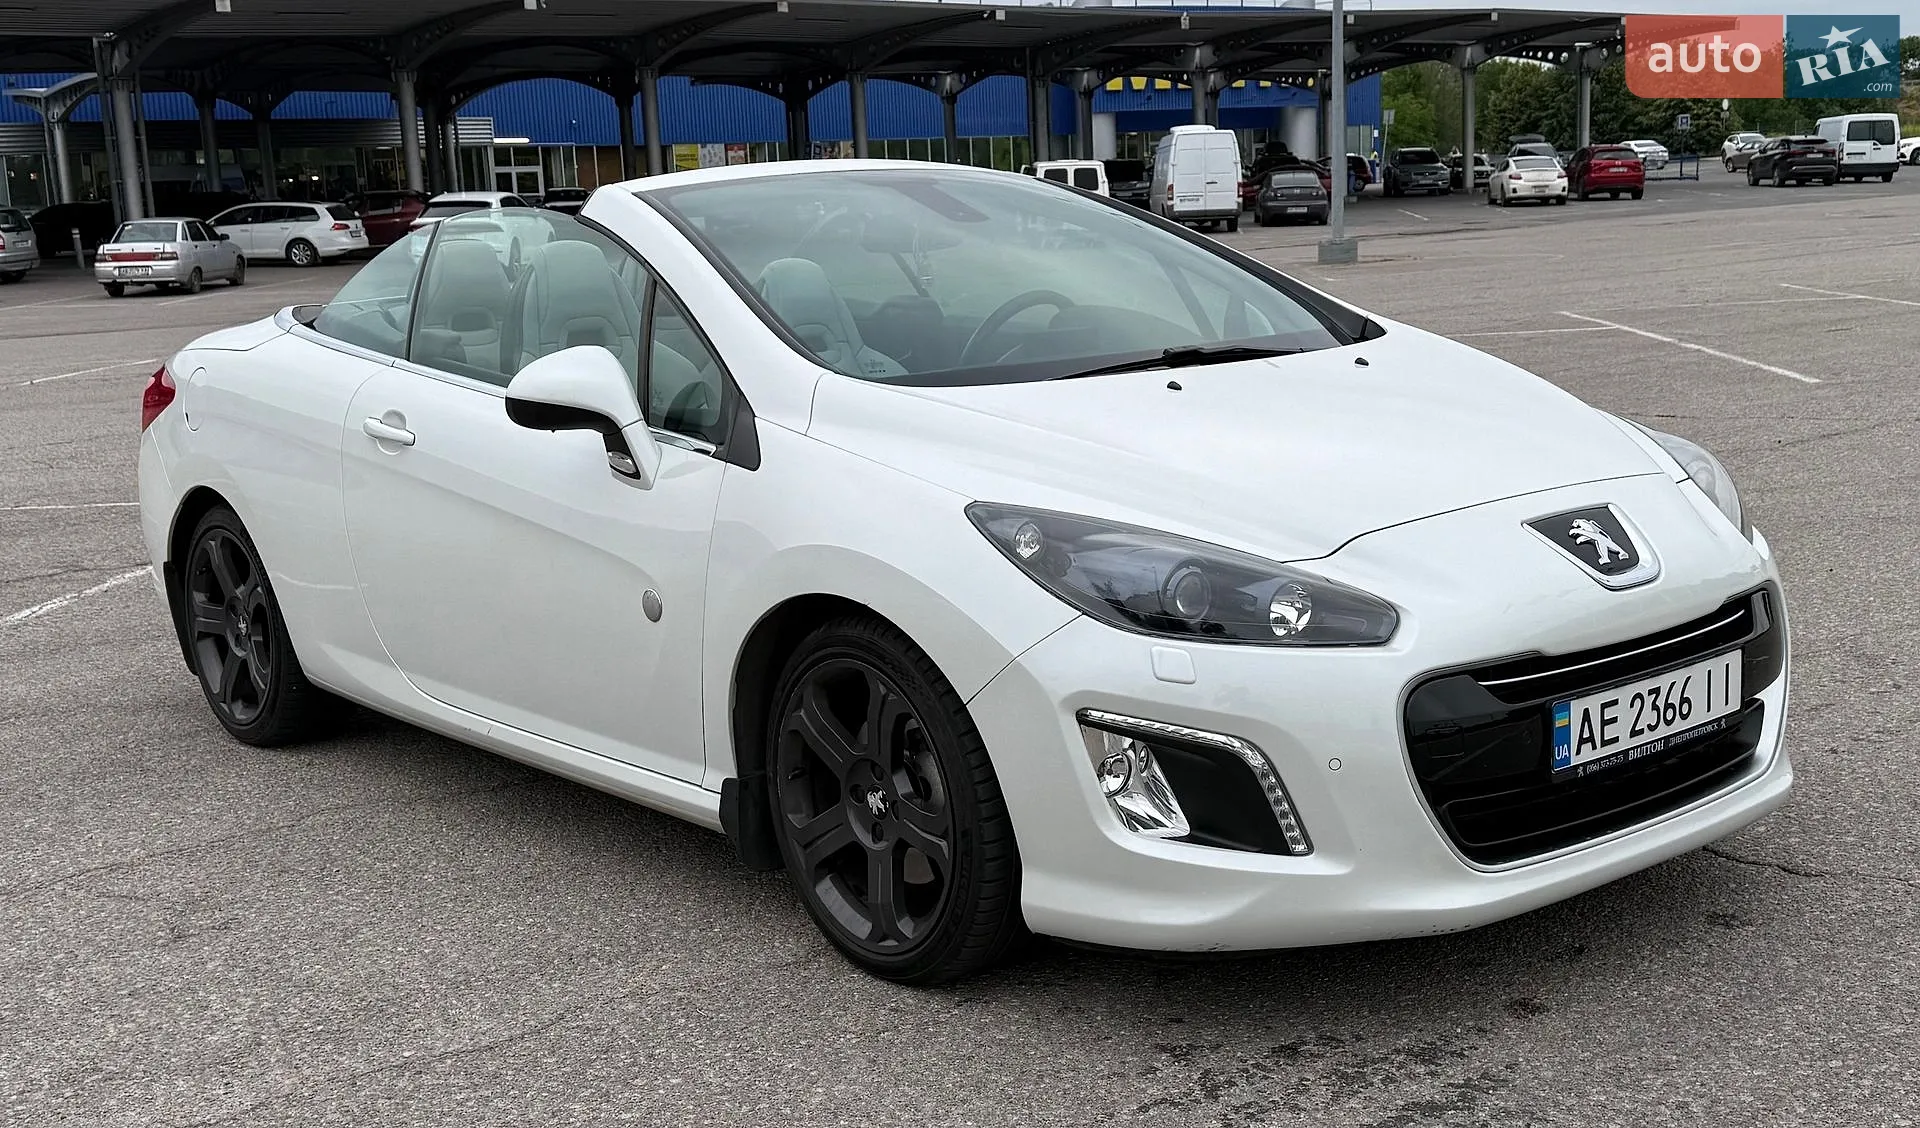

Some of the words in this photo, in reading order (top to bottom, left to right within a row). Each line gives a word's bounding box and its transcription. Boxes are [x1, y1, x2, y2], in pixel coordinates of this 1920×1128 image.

[1575, 698, 1620, 756] AE
[1629, 675, 1693, 739] 2366
[1555, 744, 1570, 760] UA
